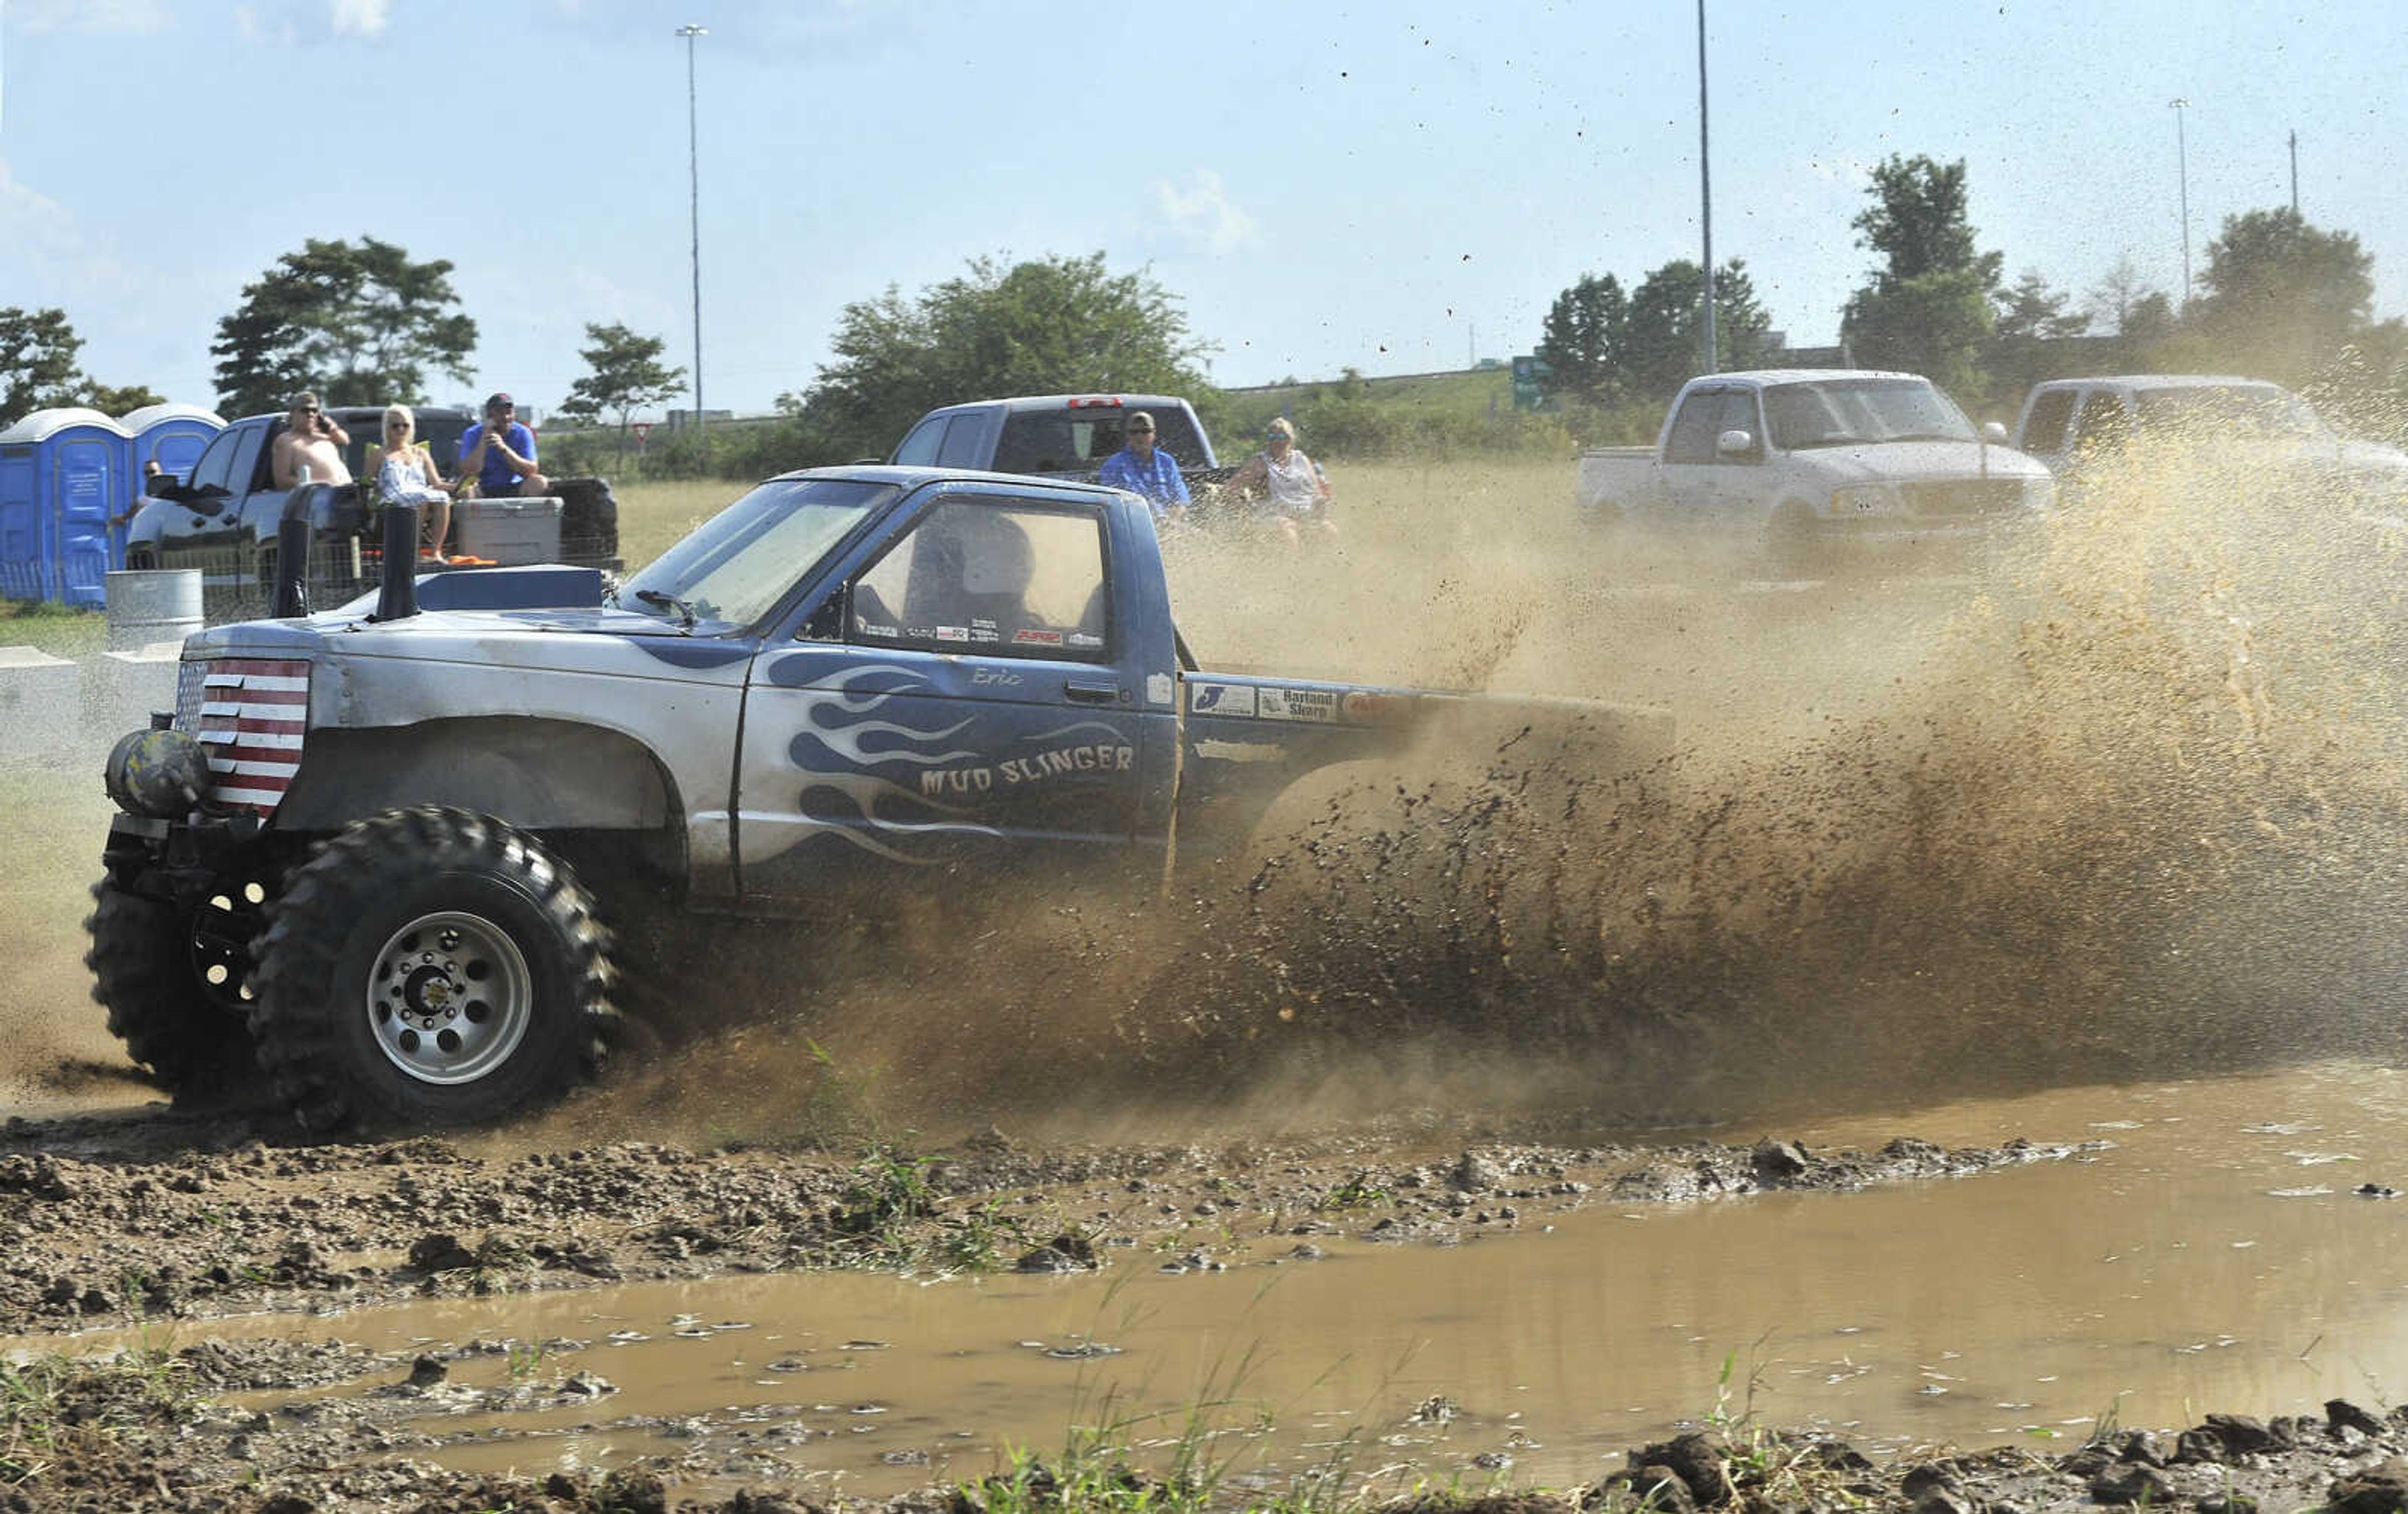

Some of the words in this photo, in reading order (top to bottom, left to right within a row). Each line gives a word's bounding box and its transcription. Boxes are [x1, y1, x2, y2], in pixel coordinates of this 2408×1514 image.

[973, 667, 1023, 686] Eric
[1284, 687, 1333, 706] Harland
[921, 768, 991, 795] MUD
[999, 745, 1134, 784] SLINGER
